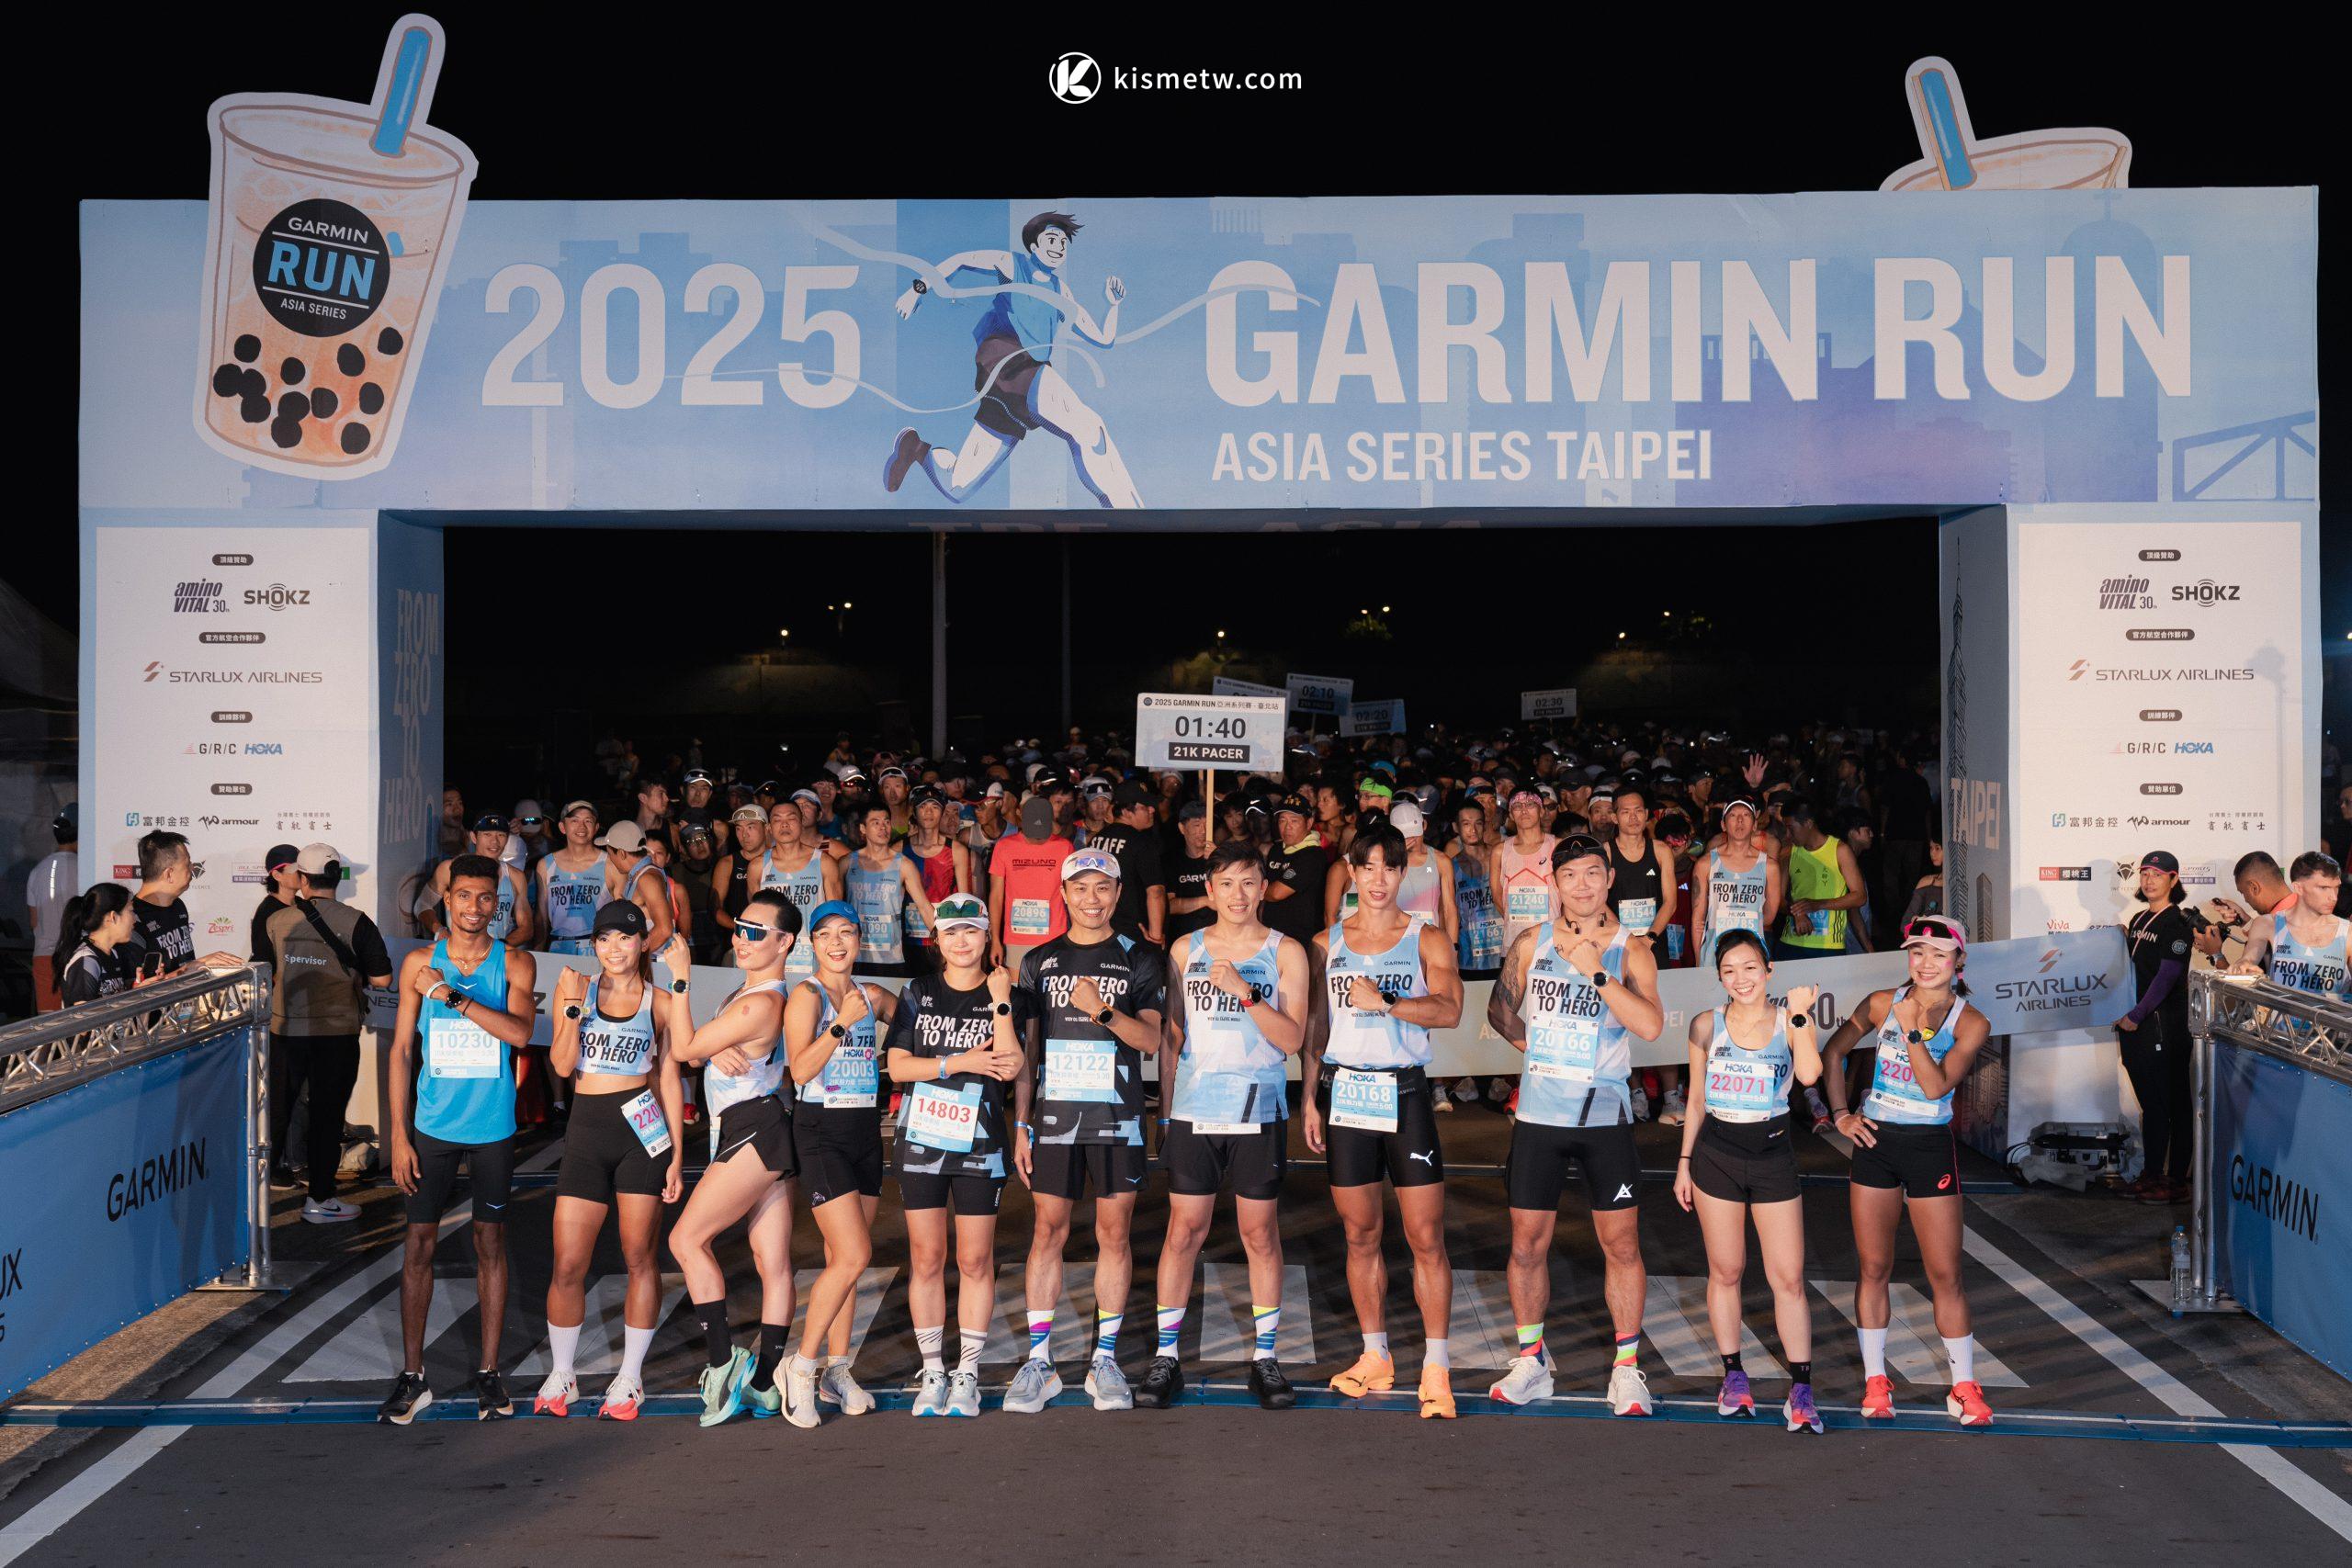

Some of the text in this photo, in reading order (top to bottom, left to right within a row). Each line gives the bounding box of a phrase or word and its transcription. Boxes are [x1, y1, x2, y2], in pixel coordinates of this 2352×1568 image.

[288, 217, 368, 244] GARMIN
[267, 240, 375, 300] RUN
[280, 298, 347, 320] ASIA SERIES
[481, 262, 861, 409] 2025
[1205, 255, 2191, 407] GARMIN RUN
[1212, 429, 1711, 481] ASIA SERIES TAIPEI
[175, 578, 223, 597] amino
[2099, 574, 2150, 593] amino
[243, 589, 311, 605] SHOKZ
[2098, 593, 2136, 609] VITAL
[2171, 585, 2240, 601] SHOKZ
[174, 597, 209, 613] VITAL
[396, 589, 439, 656] FROM
[169, 671, 322, 683] STARLUX AIRLINES
[2096, 669, 2254, 682] STARLUX AIRLINES
[1302, 685, 1334, 699] 02:10
[1154, 698, 1172, 706] 2025
[1173, 699, 1200, 707] GARMIN
[1217, 701, 1251, 709] 亞洲系列賽
[1535, 698, 1563, 707] 02:30
[1355, 710, 1388, 721] 02:20
[1175, 716, 1246, 739] 01:40
[198, 743, 237, 755] G/R/C
[244, 743, 283, 755] HOKA
[1173, 746, 1244, 760] 21K PACER
[2127, 742, 2166, 754] G/R/C
[2174, 741, 2214, 754] HOKA
[142, 816, 190, 827] 富邦金控
[221, 818, 259, 826] armour
[1951, 777, 2001, 851] TAIPEI
[2069, 817, 2119, 828] 富邦金控
[1091, 836, 1126, 854] STAFF
[1179, 873, 1207, 883] GARM
[2062, 869, 2089, 879] 櫻桃王
[550, 885, 601, 897] FROM ZERO
[794, 885, 819, 896] ZERO
[1460, 888, 1483, 903] FROM
[1713, 884, 1764, 895] FROM ZERO
[556, 895, 593, 906] TO HERO
[1467, 895, 1494, 909] TO HER
[1718, 893, 1757, 904] TO HERO
[208, 922, 235, 934] Zespri
[2046, 919, 2070, 930] Viva
[156, 928, 181, 949] FROM
[1100, 963, 1130, 972] GARMIN
[2274, 960, 2344, 981] FROM ZERO
[1091, 976, 1128, 995] ERO
[1330, 974, 1413, 994] FRO ZERO
[1532, 978, 1602, 1002] FROM ZER
[1995, 974, 2109, 999] STARLUX
[2281, 974, 2335, 991] TO HERO
[1050, 990, 1069, 1008] TO
[1194, 996, 1246, 1012] TO HER
[1538, 996, 1600, 1018] TO HERO
[2016, 995, 2091, 1012] AIRLINES
[915, 1013, 956, 1032] FROM
[436, 1032, 493, 1048] 10230
[580, 1031, 650, 1053] ROM ZERO
[922, 1029, 986, 1049] TO HERO
[581, 1045, 638, 1064] TO HERO
[843, 1049, 864, 1058] HOKA
[831, 1061, 875, 1077] 20003
[1053, 1055, 1108, 1071] 12122
[1724, 1063, 1753, 1074] HOKA
[1880, 1059, 1913, 1082] 220
[1349, 1073, 1376, 1083] HOKA
[1711, 1074, 1765, 1095] 22071
[638, 1091, 653, 1107] HOK
[1337, 1081, 1391, 1102] 20168
[634, 1104, 661, 1130] 220
[919, 1098, 971, 1122] 14803
[107, 1136, 206, 1222] GARMIN
[2231, 1154, 2319, 1243] GARMIN
